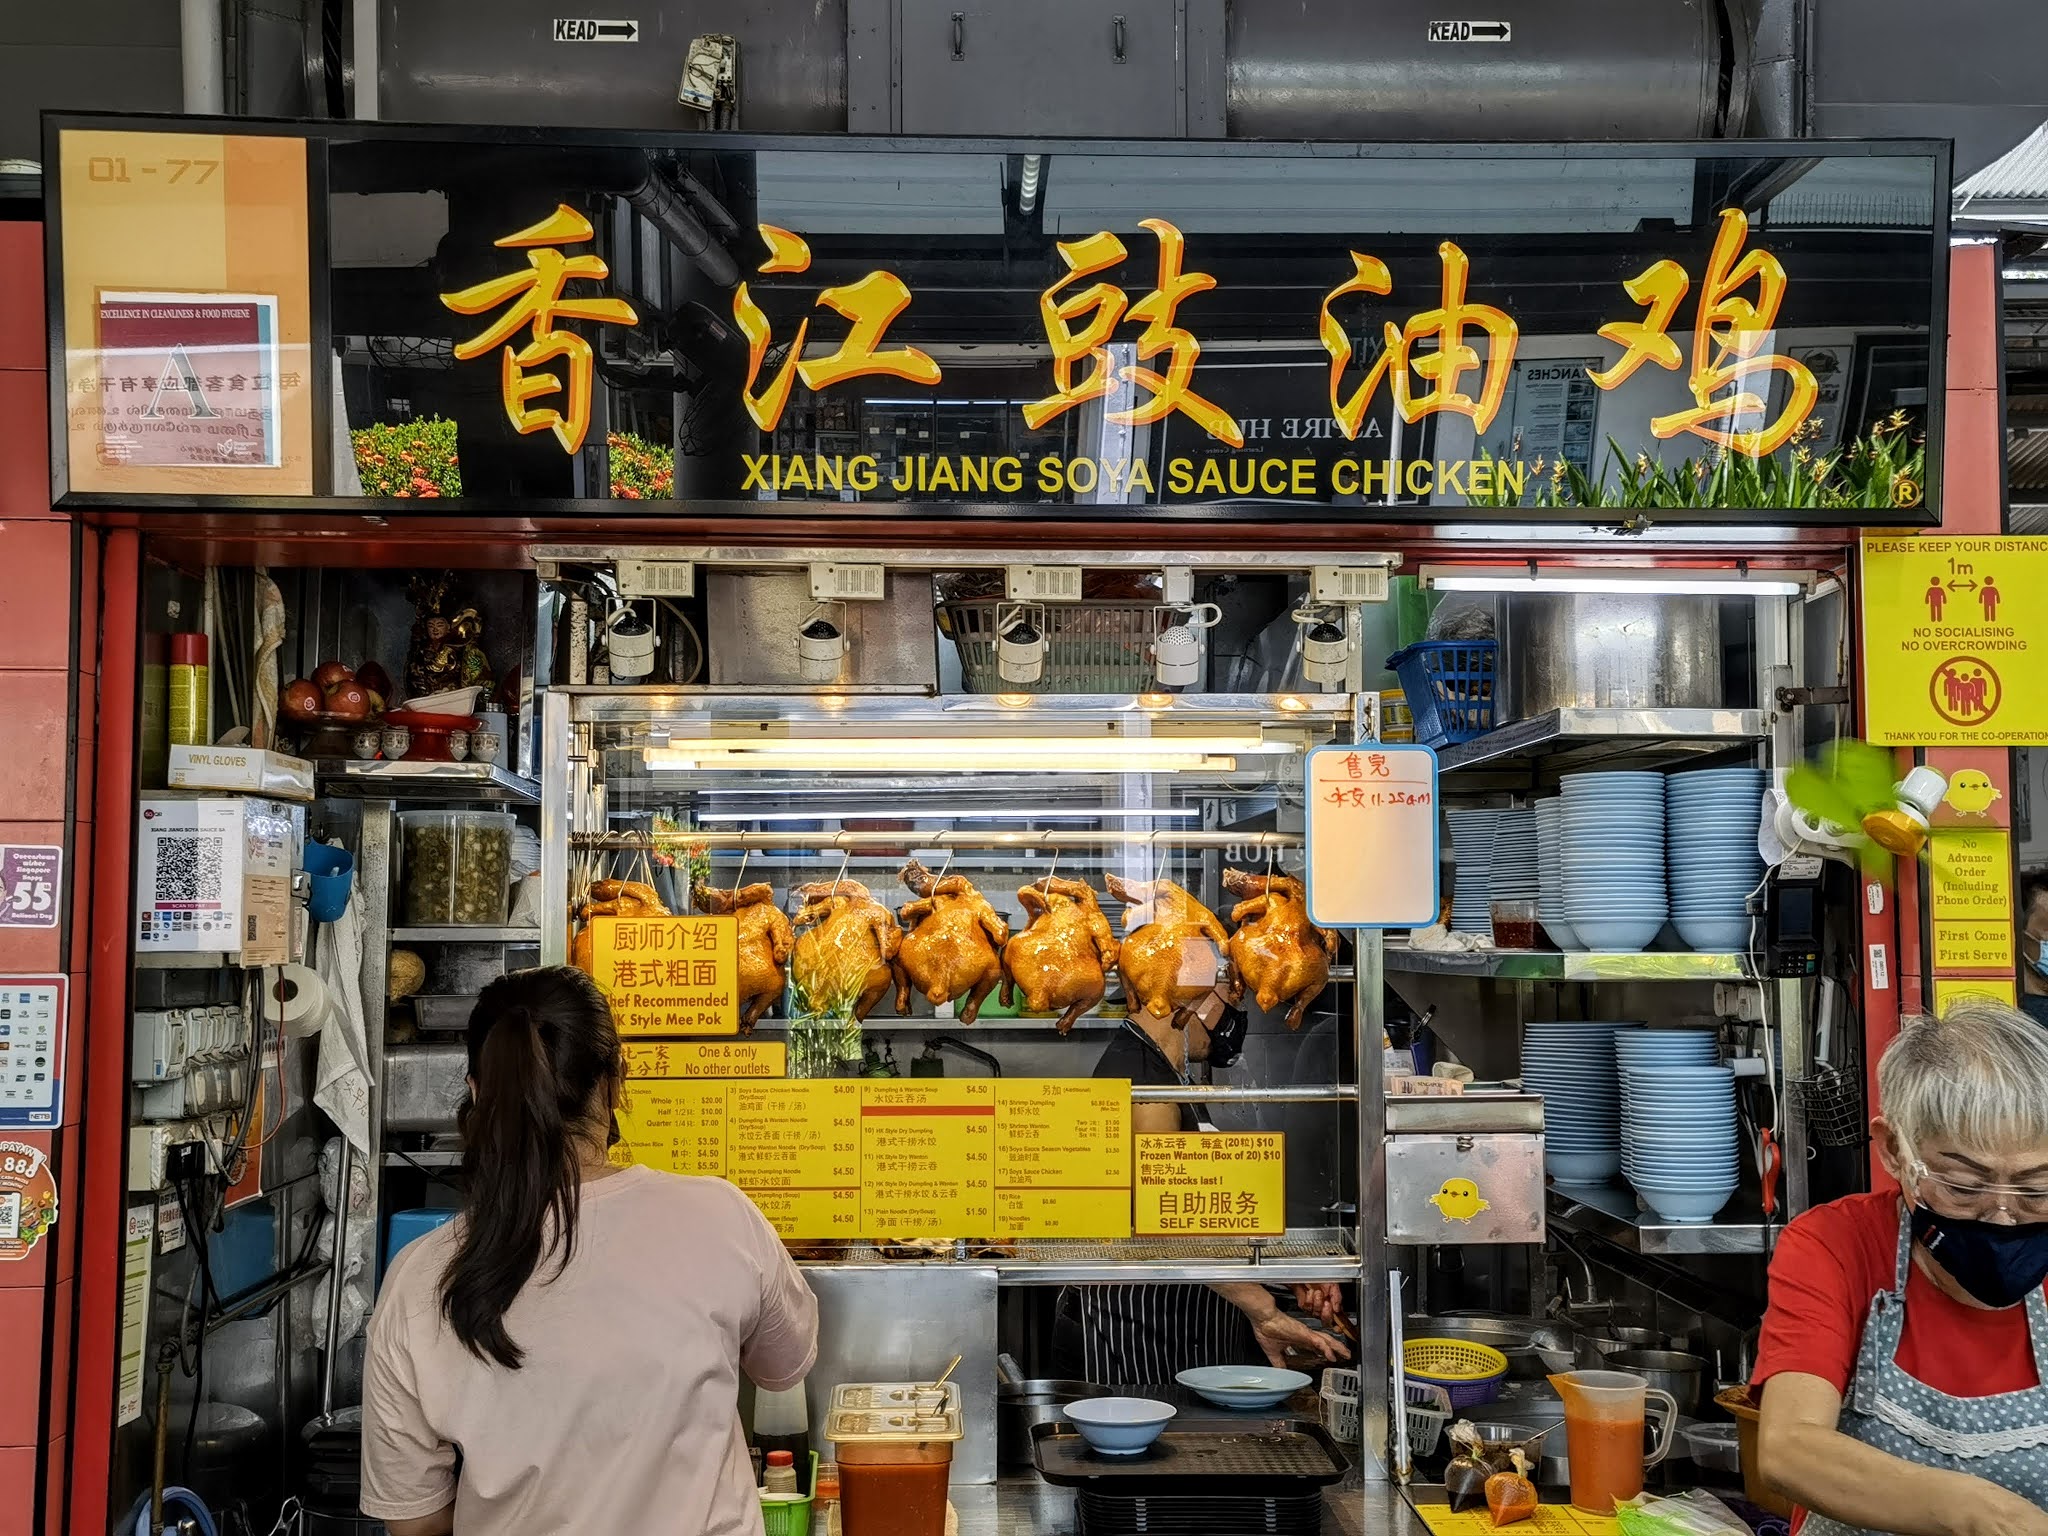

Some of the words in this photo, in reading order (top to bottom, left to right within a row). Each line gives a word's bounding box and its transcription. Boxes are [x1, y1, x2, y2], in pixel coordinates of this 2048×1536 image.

[555, 20, 597, 40] KEAD
[1430, 22, 1470, 40] KEAD
[89, 157, 131, 183] 01
[166, 159, 219, 185] 77
[100, 309, 141, 318] EXCELLENCE
[142, 309, 149, 318] IN
[151, 309, 194, 318] CLEANLINESS
[195, 310, 201, 318] &
[202, 310, 220, 318] FOOD
[221, 310, 250, 319] HYGIENE
[140, 343, 221, 420] A
[741, 454, 878, 491] XIANG
[892, 456, 1023, 493] JIANG
[1037, 456, 1155, 494] SOYA
[1167, 458, 1317, 495] SAUCE
[1331, 459, 1524, 495] CHICKEN
[1867, 542, 1915, 553] PLEASE
[1919, 542, 1951, 552] KEEP
[1955, 541, 1991, 551] YOUR
[1994, 541, 2048, 551] DISTANC
[1947, 556, 1974, 575] 1m
[1913, 627, 1932, 638] NO
[1935, 627, 2014, 638] SOCIALISING
[1902, 641, 1920, 651] NO
[1923, 640, 2028, 651] OVERCROWDING
[1884, 732, 1916, 741] THANK
[1918, 732, 1938, 741] YOU
[1941, 732, 1958, 741] FOR
[1961, 732, 1979, 740] THE
[188, 754, 212, 765] VINYL
[213, 755, 247, 767] GLOVES
[1962, 839, 1977, 848] No
[1947, 853, 1993, 863] Advance
[1955, 867, 1986, 877] Order
[1943, 881, 1999, 893] (Including
[12, 882, 52, 911] 55
[1936, 895, 1970, 905] Phone
[1972, 895, 2007, 907] Order)
[613, 922, 718, 951] 厨师介绍
[1939, 930, 1970, 941] First
[1974, 930, 2007, 941] Come
[1939, 950, 1970, 960] First
[1973, 949, 2008, 960] Serve
[613, 959, 718, 988] 港式粗面
[634, 992, 729, 1008] Recommended
[630, 1013, 662, 1029] Style
[666, 1013, 694, 1026] Mee
[697, 1012, 722, 1026] Pok
[698, 1046, 720, 1058] One
[723, 1046, 732, 1058] &
[735, 1046, 757, 1061] only
[685, 1063, 701, 1075] No
[703, 1062, 730, 1075] other
[734, 1062, 771, 1075] outlets
[834, 1085, 855, 1094] $4.00
[966, 1085, 988, 1094] $4.50
[651, 1097, 672, 1105] Whole
[646, 1120, 672, 1128] Quarter
[834, 1118, 855, 1127] $4.50
[966, 1125, 988, 1134] $4.50
[673, 1138, 679, 1146] S
[698, 1137, 719, 1146] $3.50
[1140, 1137, 1187, 1149] 冰冻云吞
[1200, 1137, 1223, 1149] 每盒
[1256, 1137, 1274, 1148] $10
[833, 1143, 855, 1152] $3.50
[671, 1150, 678, 1158] M
[698, 1149, 719, 1158] $4.50
[966, 1152, 988, 1161] $4.50
[1140, 1150, 1171, 1160] Frozen
[1174, 1150, 1209, 1160] Wanton
[1211, 1150, 1232, 1162] (Box
[1235, 1150, 1244, 1160] of
[1246, 1150, 1261, 1162] 20)
[1263, 1150, 1281, 1161] $10
[698, 1161, 719, 1170] $5.50
[1140, 1163, 1187, 1175] 售完为止
[833, 1167, 855, 1176] $4.50
[966, 1179, 988, 1188] $4.50
[1141, 1176, 1166, 1185] While
[1168, 1176, 1198, 1185] stocks
[1200, 1176, 1218, 1185] last
[833, 1191, 855, 1200] $4.50
[1159, 1190, 1259, 1215] 自助服务
[966, 1207, 988, 1216] $1.50
[833, 1214, 855, 1223] $4.50
[1160, 1218, 1195, 1229] SELF
[1200, 1218, 1260, 1229] SERVICE
